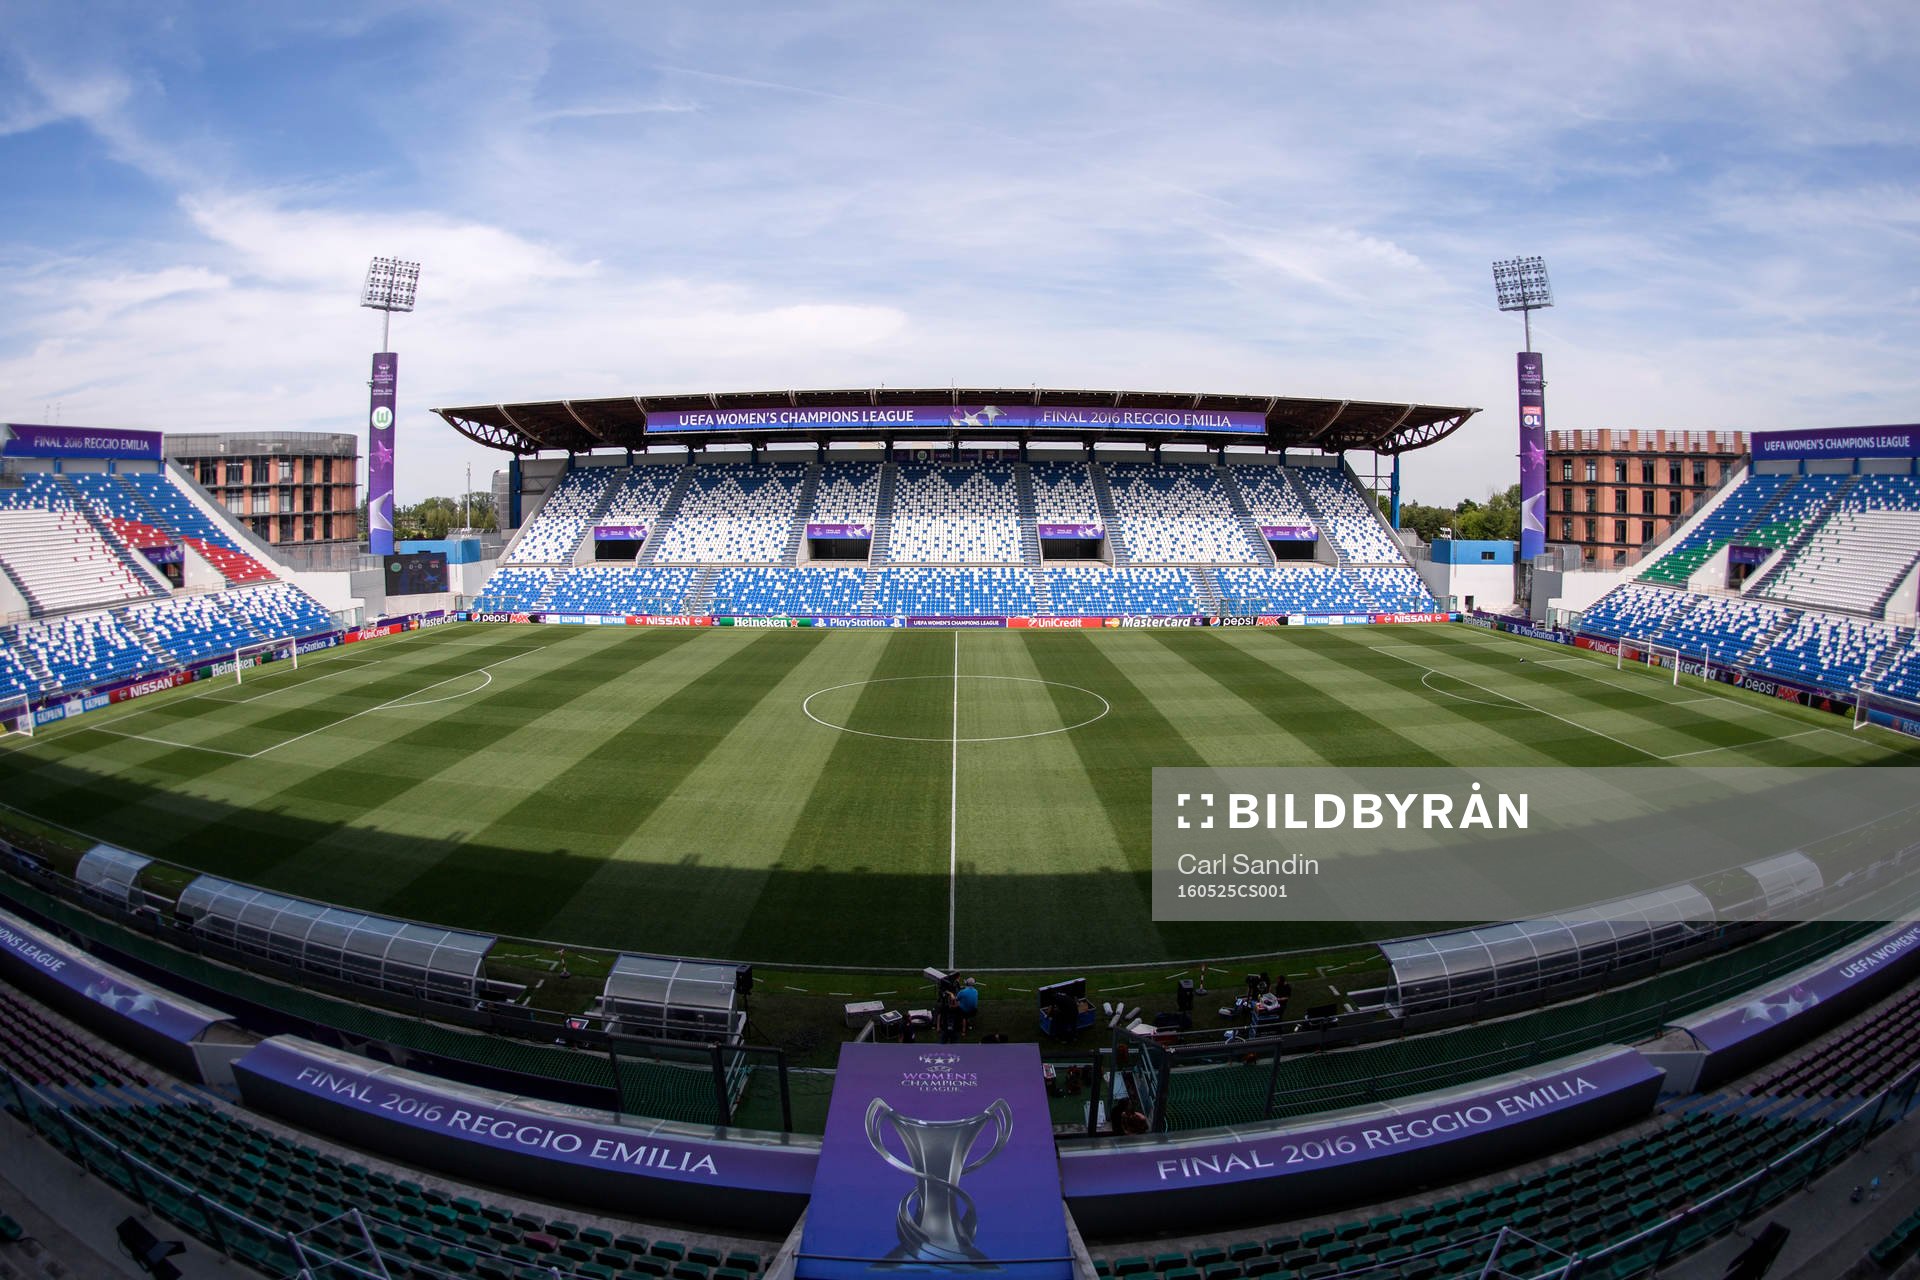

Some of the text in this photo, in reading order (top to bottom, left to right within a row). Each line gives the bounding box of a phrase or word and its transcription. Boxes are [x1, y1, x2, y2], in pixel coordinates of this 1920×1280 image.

[679, 410, 914, 426] UEFA WOMEN'S CHAMPIONS LEAGUE
[1043, 411, 1232, 428] FINAL 2016 REGGIO EMILIA
[34, 436, 150, 451] FINAL 2016 REGGIO EMILIA
[1764, 435, 1911, 452] UEFA WOMEN'S CHAMPIONS LEAGUE
[420, 613, 458, 629] MasterCard
[482, 613, 532, 624] pepsi MAX
[646, 616, 690, 625] NISSAN
[733, 617, 788, 627] Heineken
[830, 618, 886, 628] PlayStation
[1038, 618, 1082, 628] UniCredit
[1122, 617, 1190, 628] MasterCard
[1223, 616, 1254, 626] pepsi
[1256, 616, 1281, 627] MAX
[1394, 614, 1432, 623] NISSAN
[1520, 626, 1554, 641] PlayStation
[130, 677, 173, 698] NISSAN
[1744, 678, 1775, 695] pepsi
[17, 942, 66, 972] LEAGUE
[1840, 956, 1880, 978] UEFA
[297, 1066, 719, 1176] FINAL 2016 REGGIO EMILIA
[1157, 1076, 1599, 1180] FINAL 2016 REGGIO EMILIA
